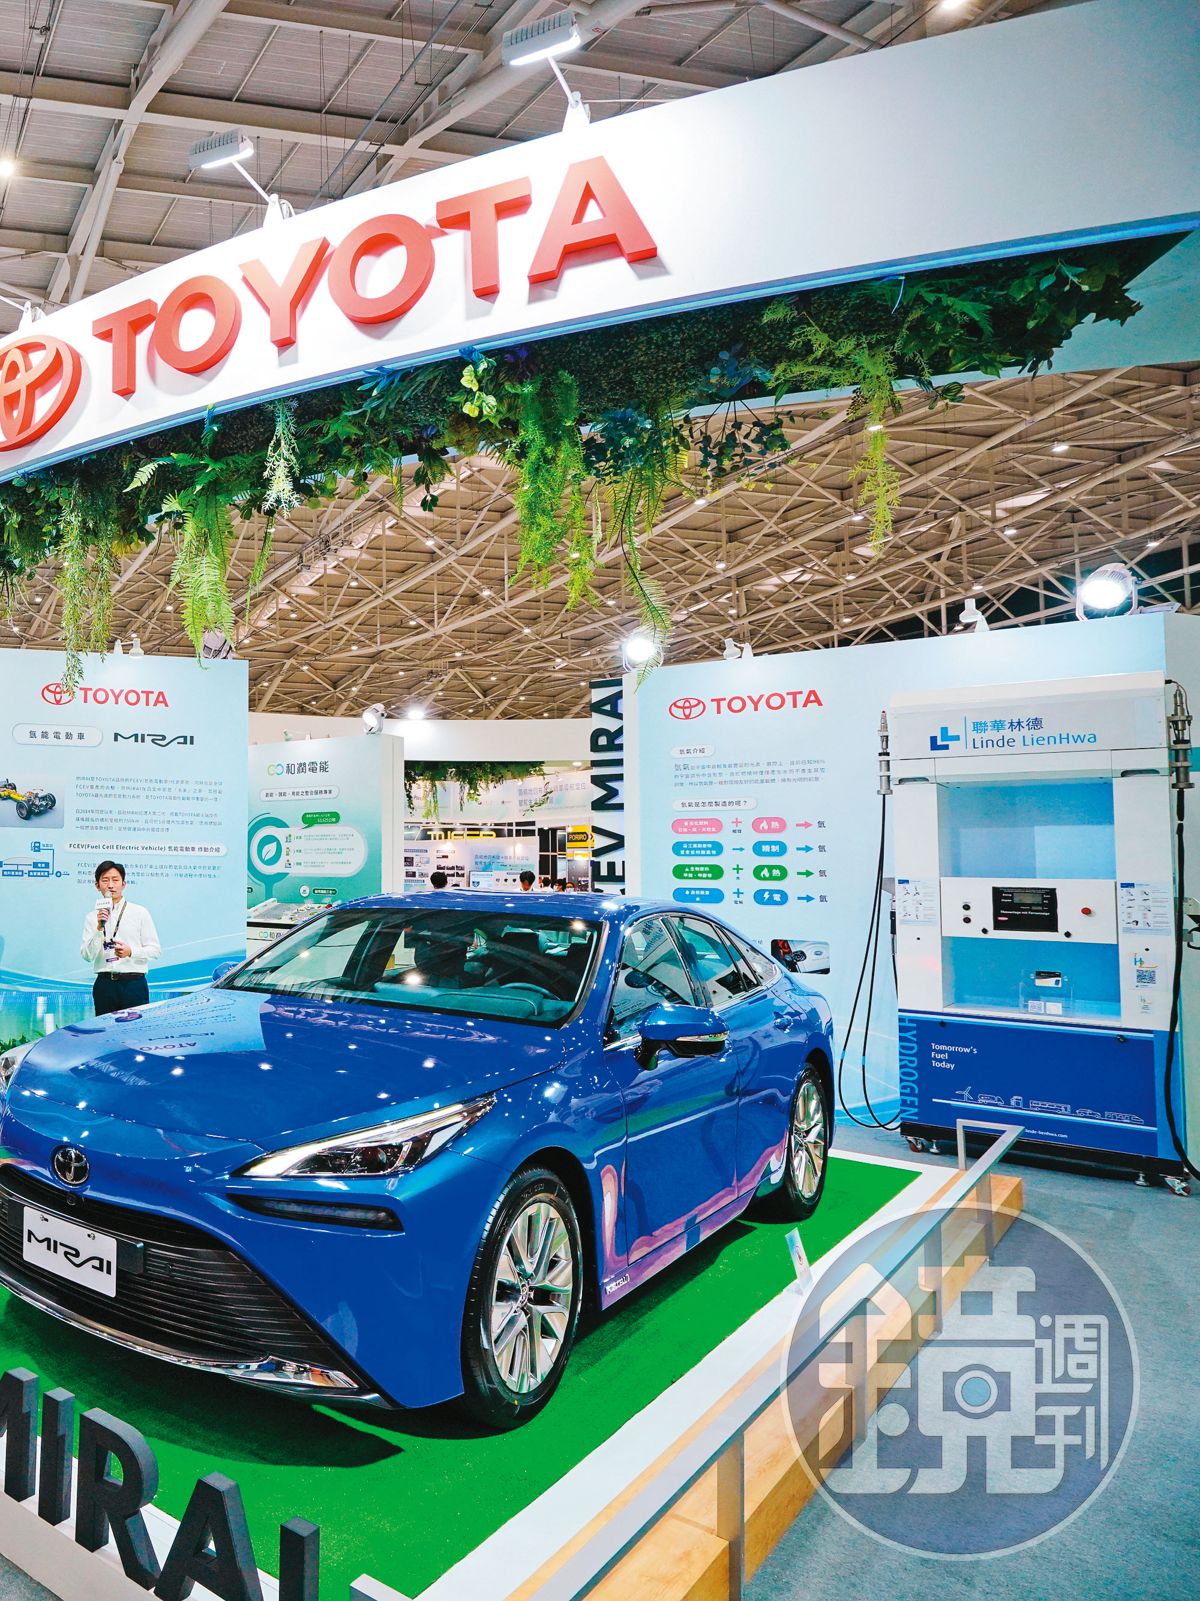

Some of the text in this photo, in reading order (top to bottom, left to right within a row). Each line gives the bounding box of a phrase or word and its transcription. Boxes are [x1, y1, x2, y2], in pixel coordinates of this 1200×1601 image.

[92, 156, 658, 397] TOYOTA
[79, 686, 169, 708] TOYOTA
[710, 689, 823, 715] TOYOTA
[971, 717, 1044, 734] 聯華林德
[29, 730, 85, 741] 氫能電動車
[113, 732, 195, 748] MIRAI
[972, 732, 1097, 749] Linde LienHwa
[589, 678, 625, 811] MIRAI
[286, 760, 329, 775] 和潤電能
[931, 1043, 978, 1054] Tomorrow's
[931, 1052, 948, 1060] Fuel
[898, 1016, 919, 1121] HYDROGEN
[931, 1060, 955, 1070] Today
[27, 1228, 112, 1276] MIRAI
